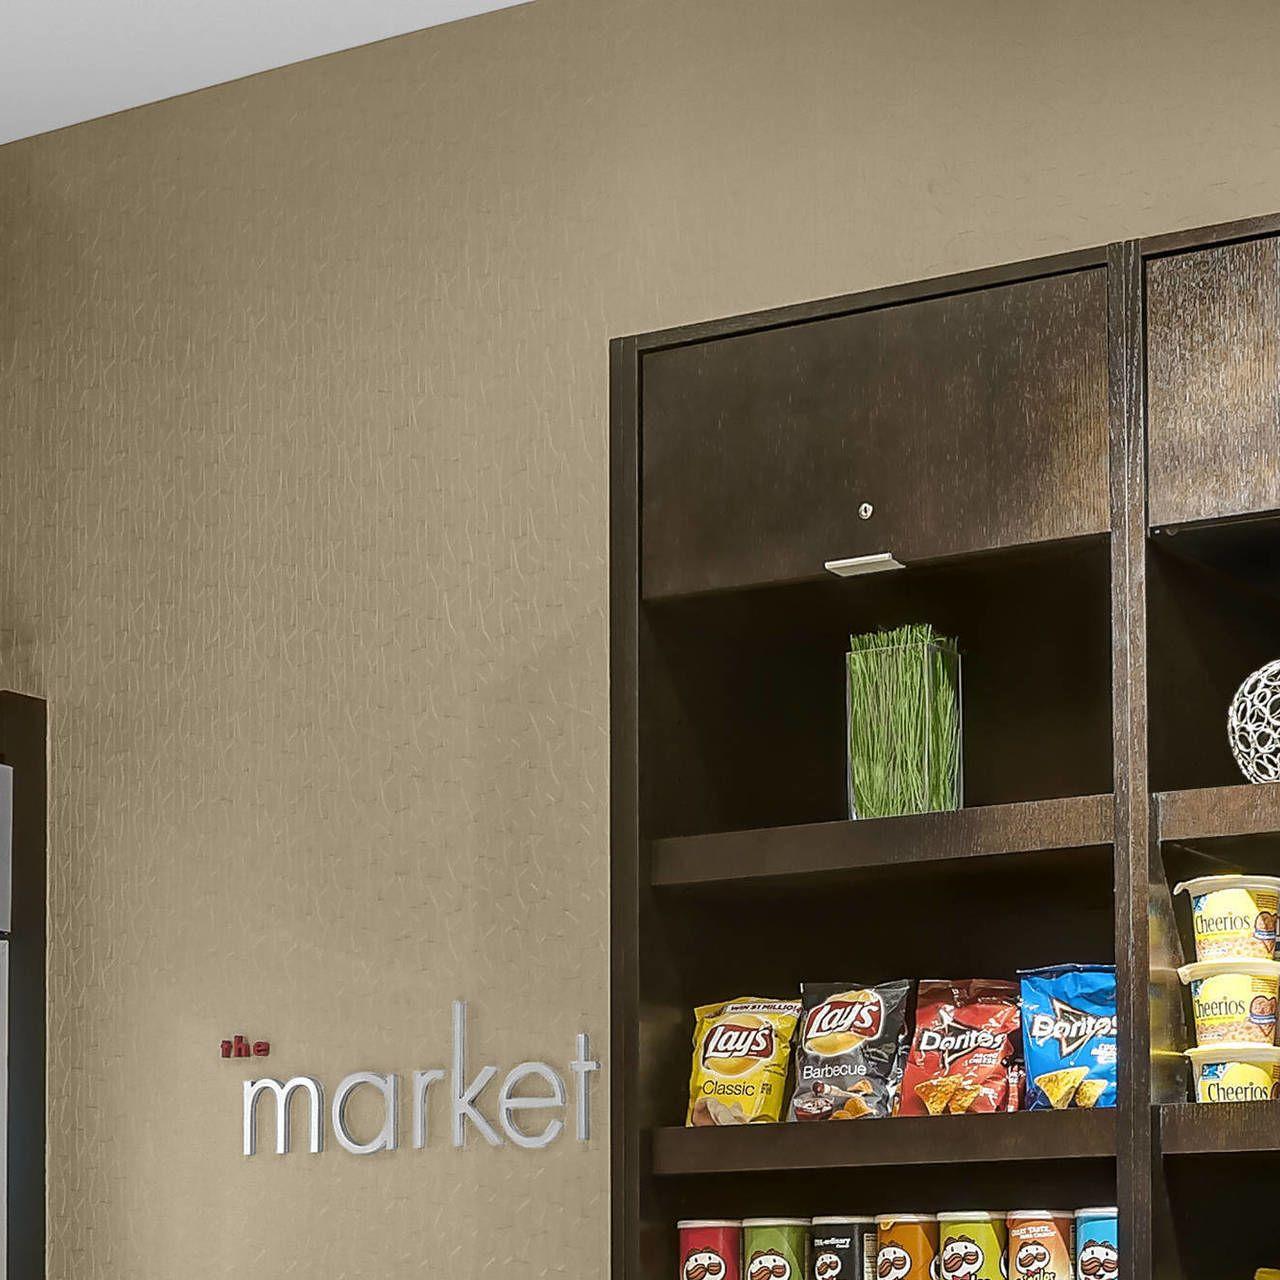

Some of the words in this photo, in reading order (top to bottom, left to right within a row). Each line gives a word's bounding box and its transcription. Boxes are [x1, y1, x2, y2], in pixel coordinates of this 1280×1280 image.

[1195, 912, 1251, 936] Cheerios
[808, 999, 879, 1038] Lay's
[220, 1034, 270, 1058] the
[705, 1022, 770, 1059] Lay's
[920, 1030, 1007, 1051] Doritos
[243, 1000, 601, 1156] market
[804, 1064, 867, 1080] Barbecue
[703, 1081, 755, 1097] Classic
[1207, 1082, 1268, 1102] Cheerios
